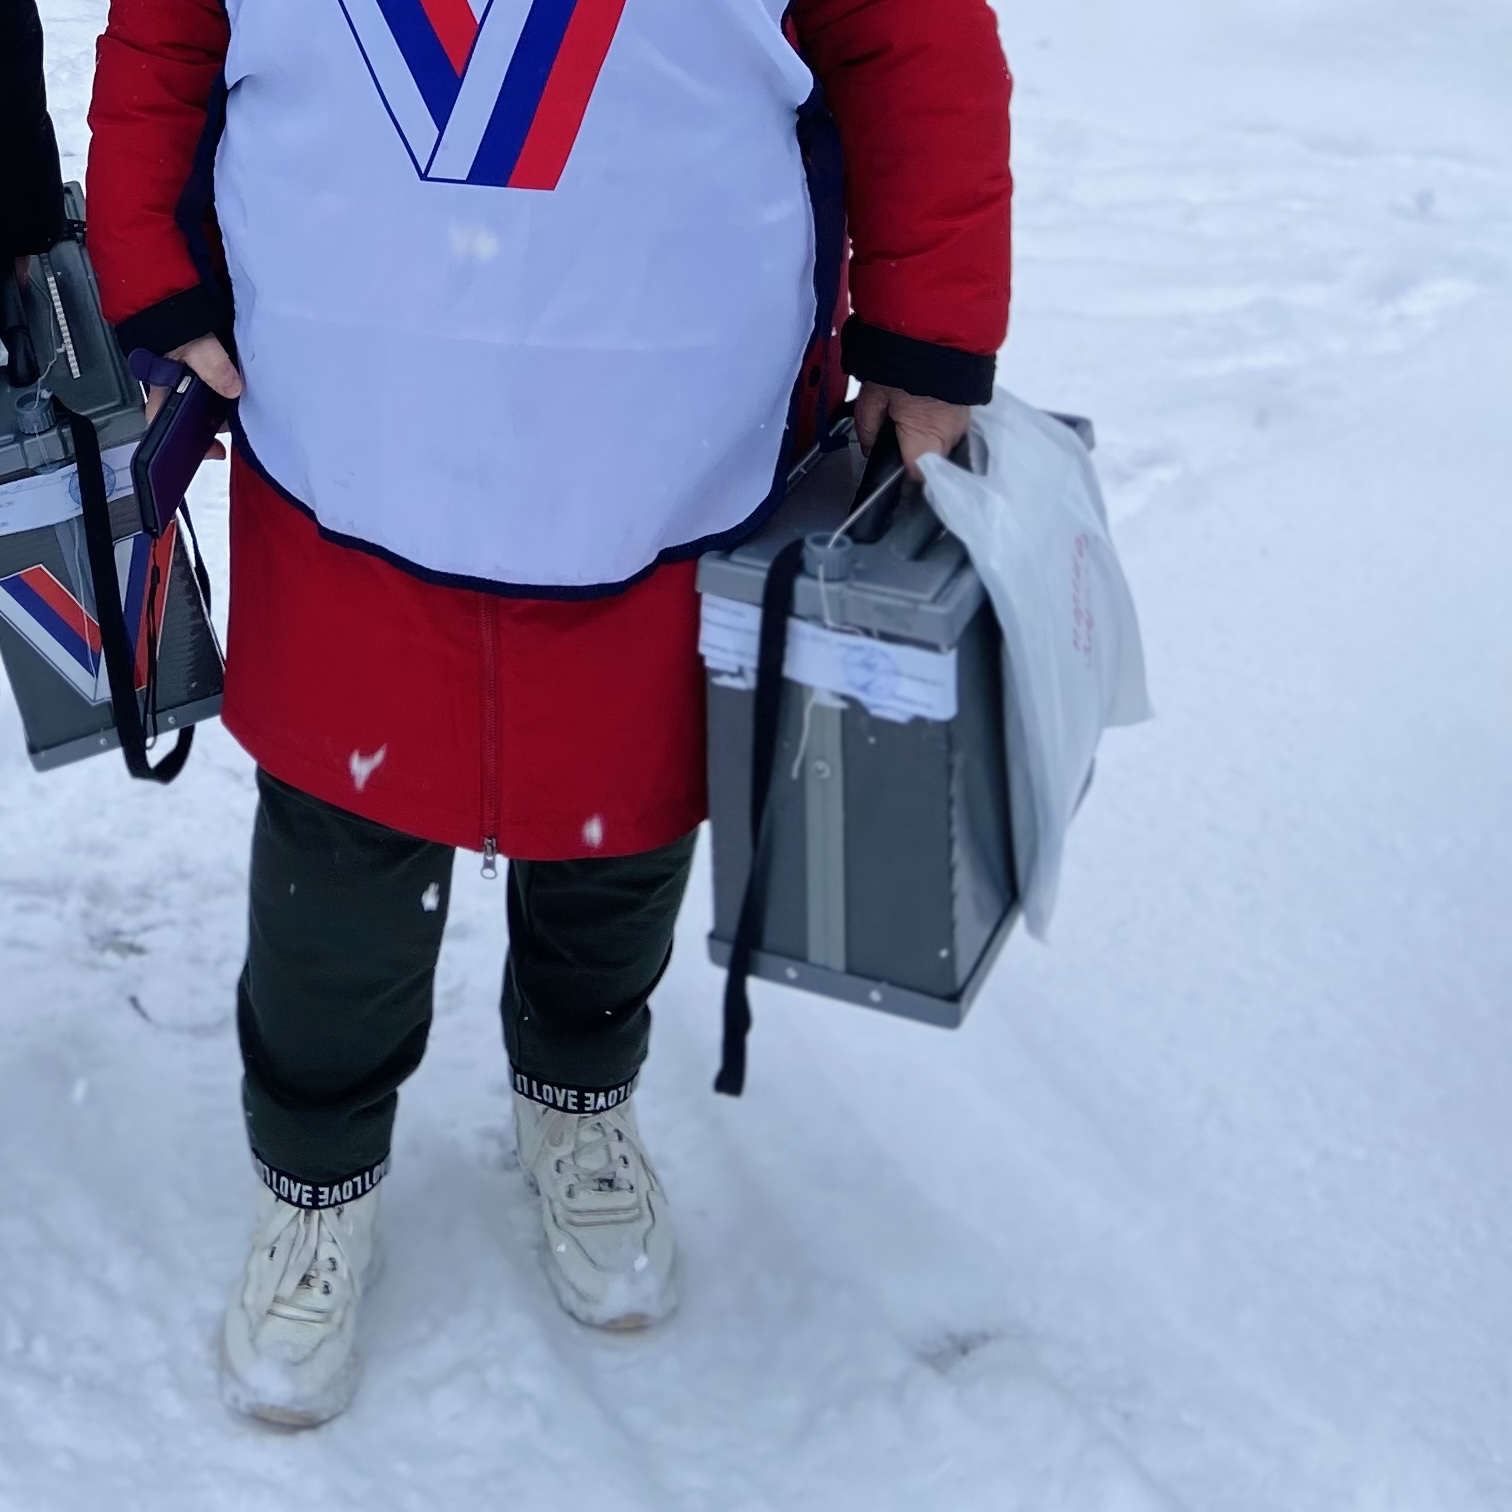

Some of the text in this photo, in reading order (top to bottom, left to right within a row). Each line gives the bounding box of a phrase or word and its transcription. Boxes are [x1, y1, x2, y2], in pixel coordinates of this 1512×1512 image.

[532, 1080, 578, 1111] LOVE
[272, 1170, 313, 1207] LOVE
[317, 1176, 363, 1207] LOVE
